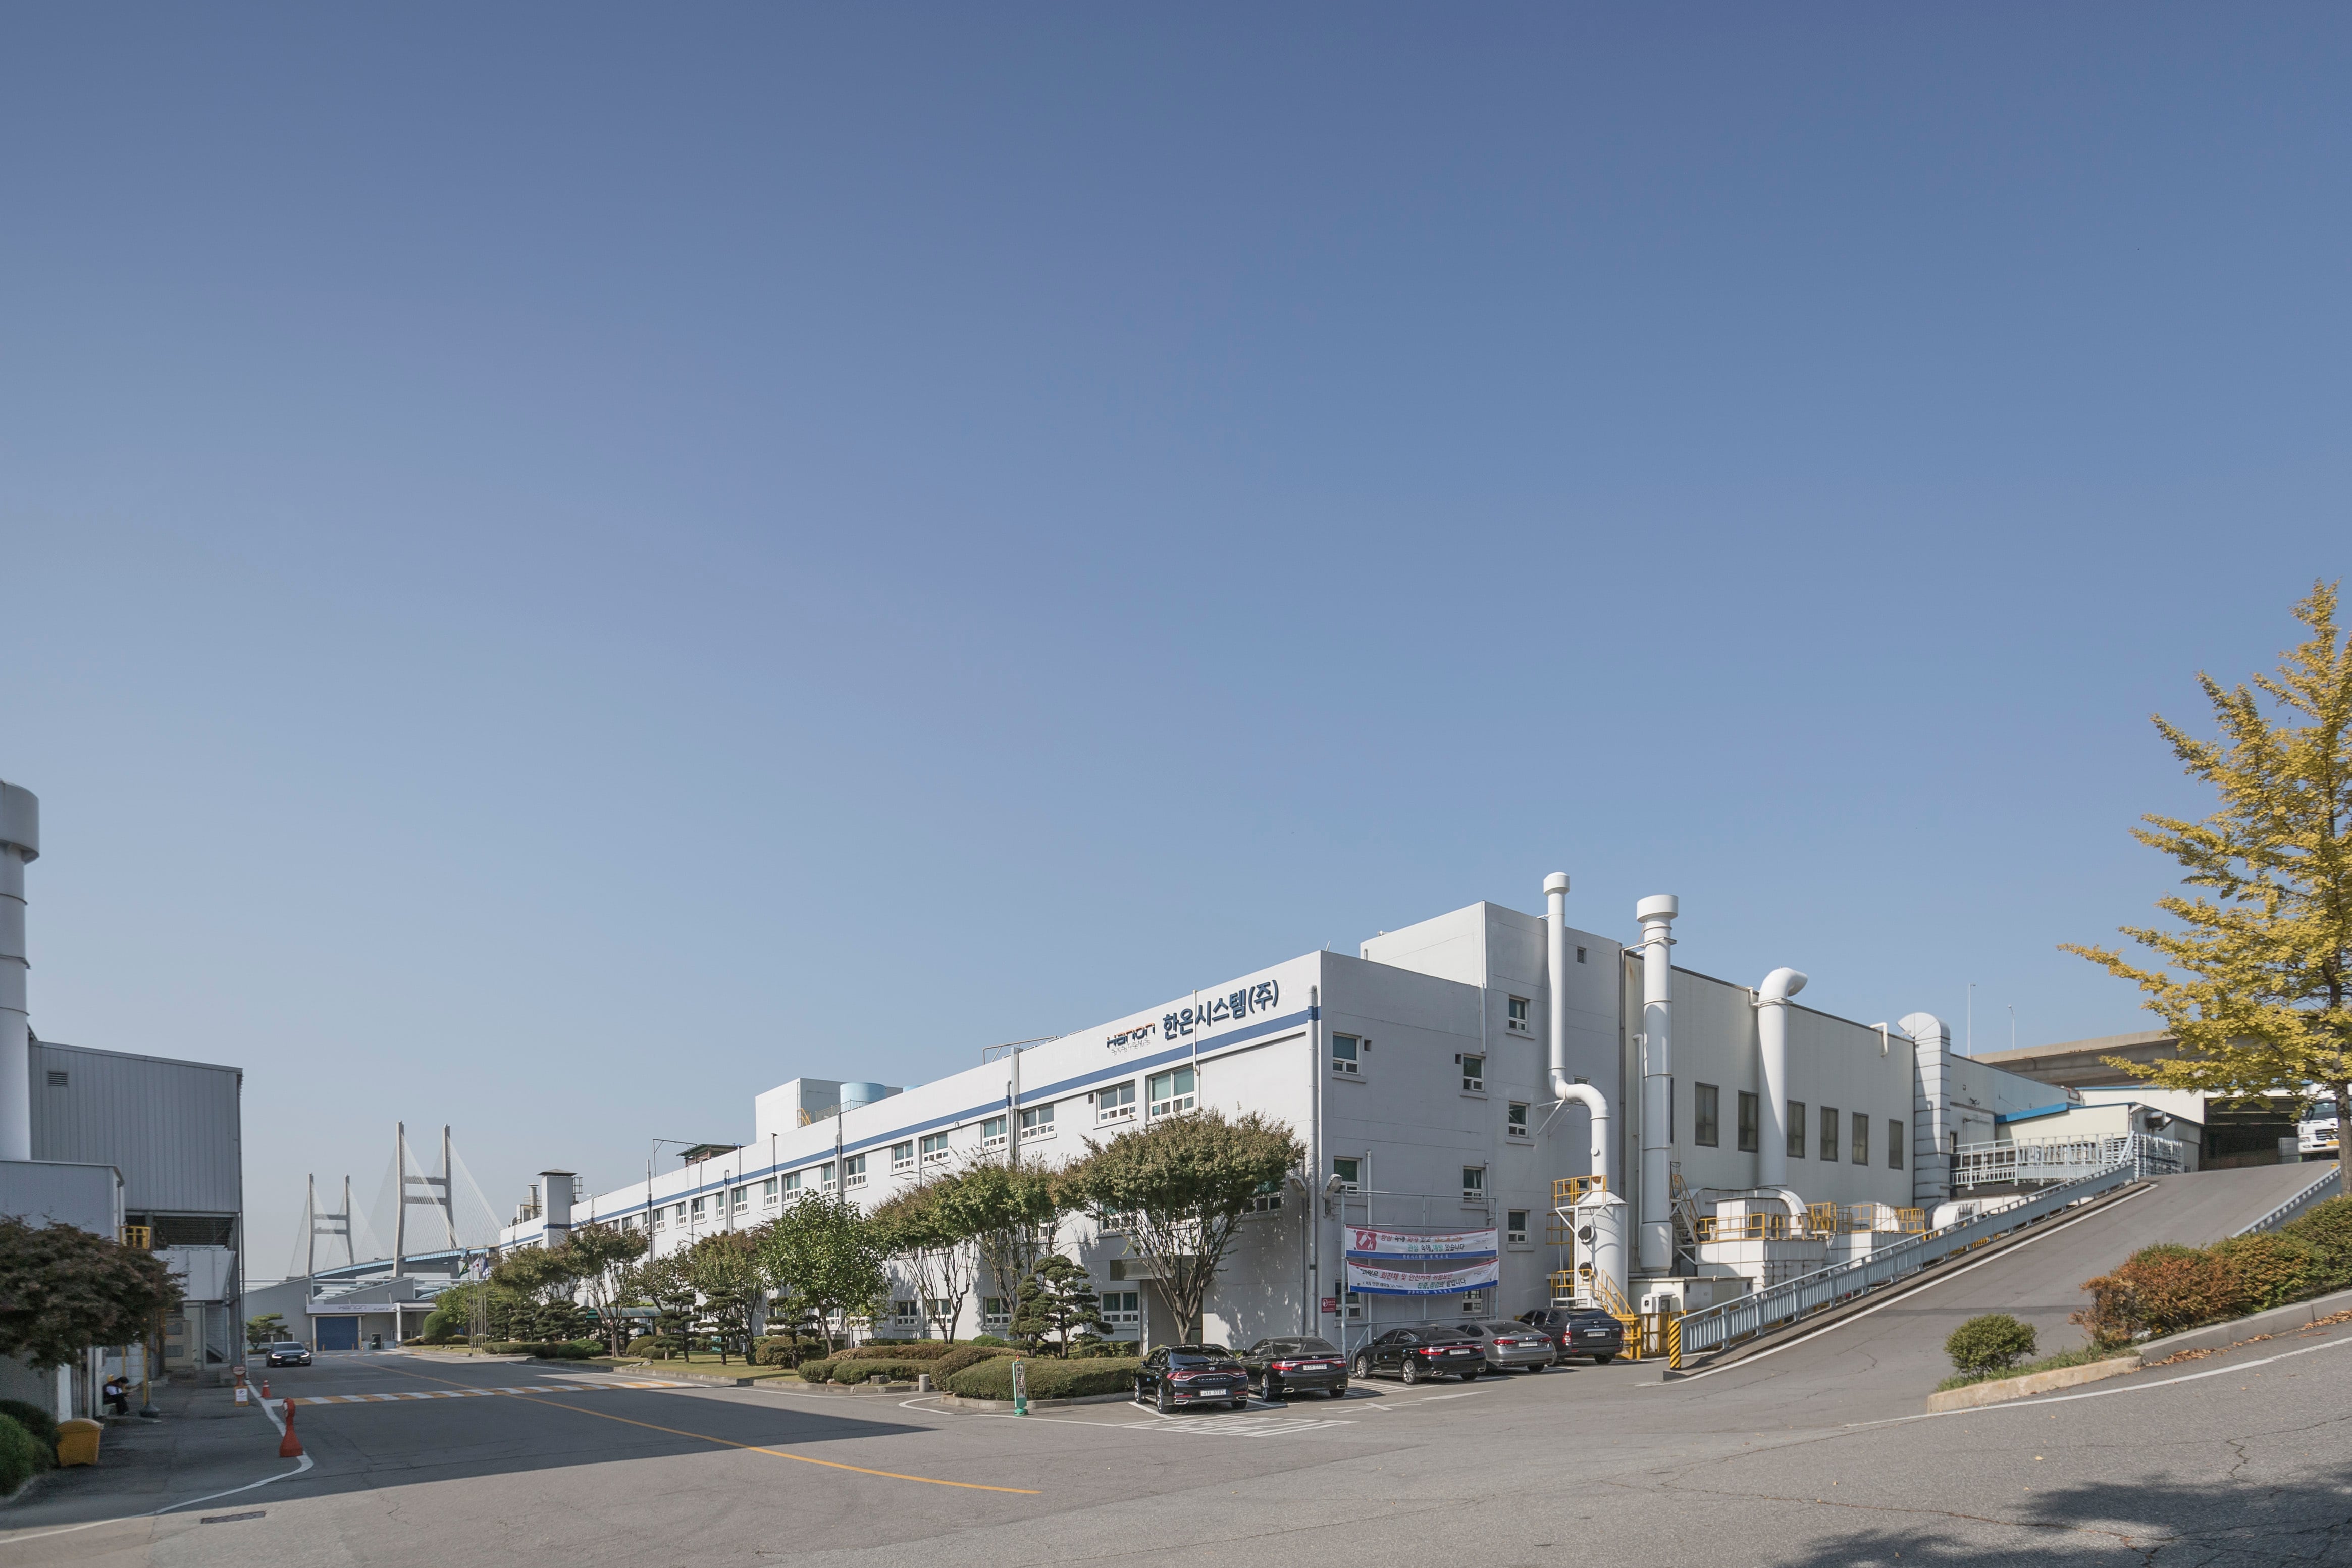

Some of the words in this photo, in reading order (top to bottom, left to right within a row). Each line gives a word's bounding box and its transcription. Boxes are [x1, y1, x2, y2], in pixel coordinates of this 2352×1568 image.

[1162, 980, 1278, 1040] 한온시스템(주)
[1111, 1038, 1151, 1056] SYSTEMS
[1445, 1243, 1465, 1251] 있습니다
[1380, 1272, 1399, 1281] 회전체
[1446, 1278, 1466, 1287] 달입니다
